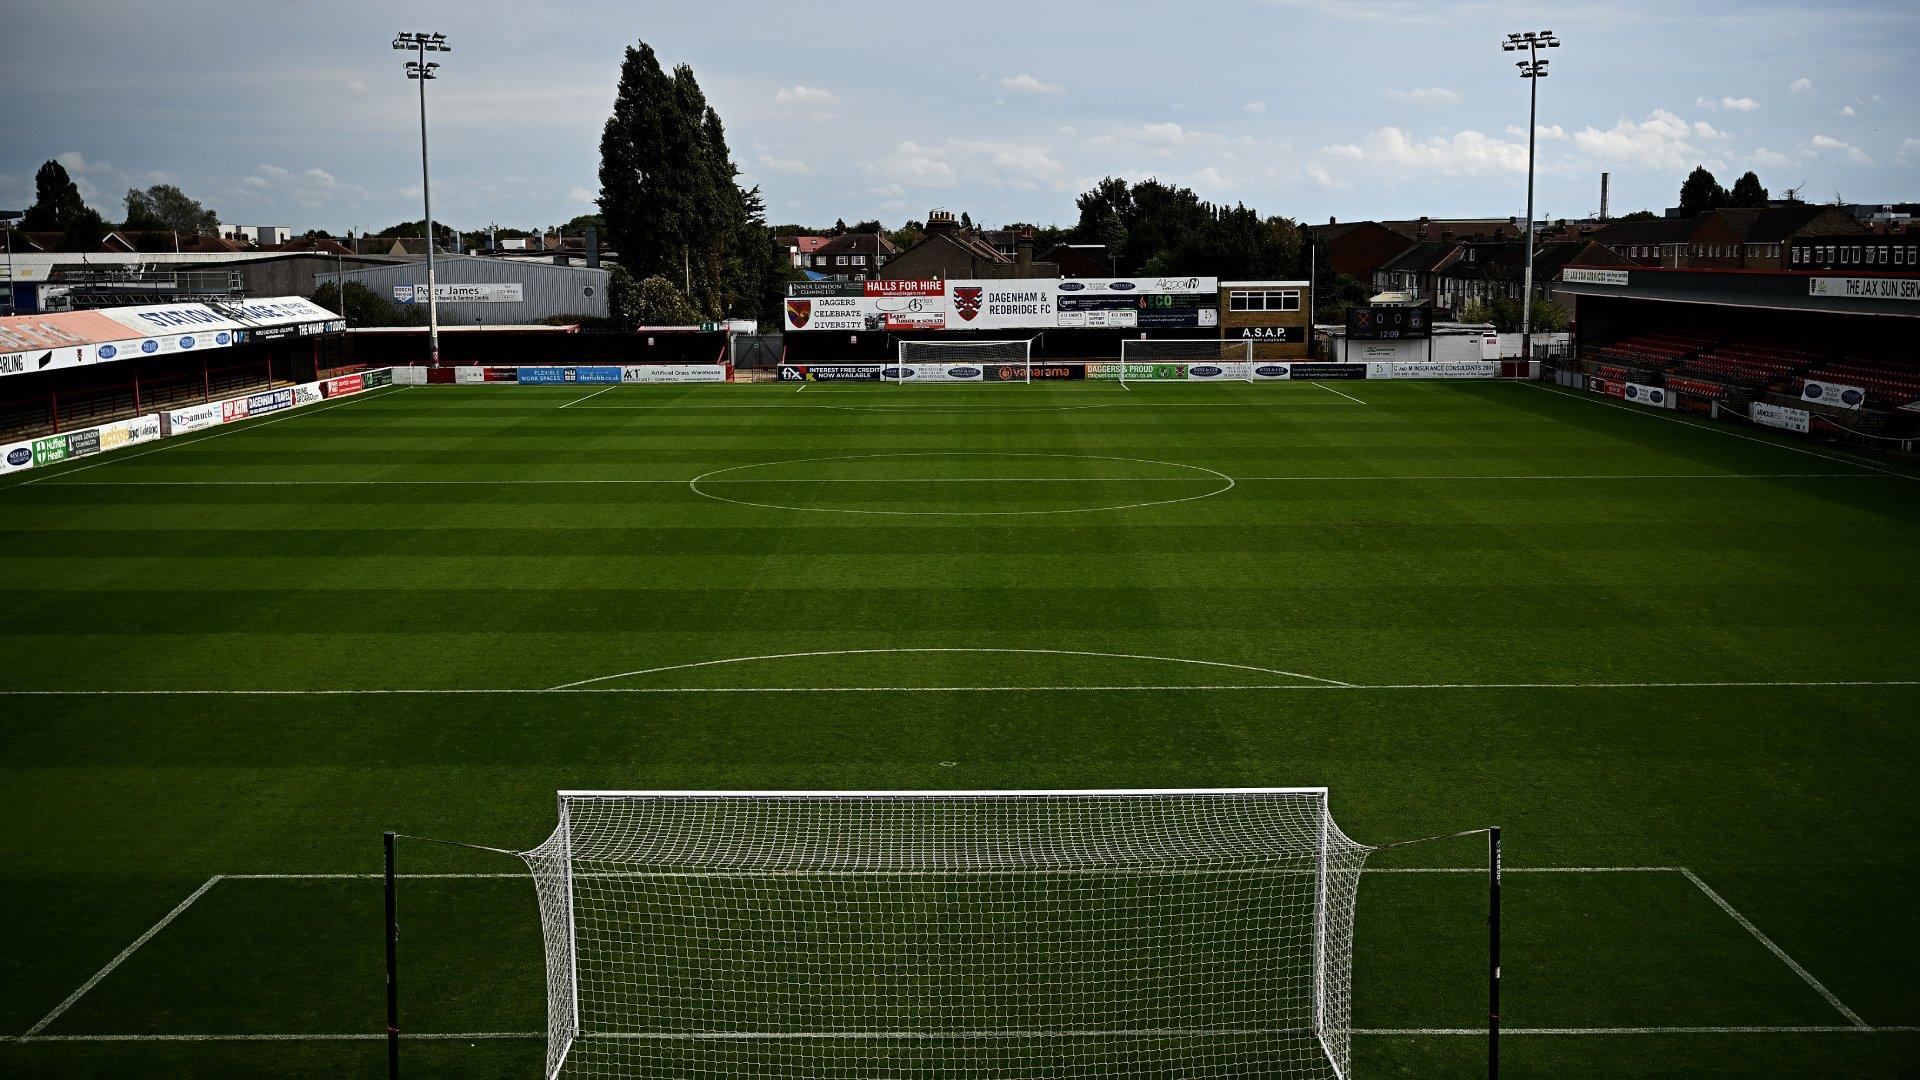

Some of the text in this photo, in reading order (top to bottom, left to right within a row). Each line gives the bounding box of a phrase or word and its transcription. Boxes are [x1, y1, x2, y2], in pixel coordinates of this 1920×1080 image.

[417, 286, 479, 295] Peer James
[867, 281, 897, 291] HALLS
[899, 281, 917, 291] FOR
[920, 281, 942, 290] HIRE
[1846, 280, 1860, 295] THE
[1861, 280, 1878, 296] JAX
[1881, 281, 1898, 297] SUN
[989, 292, 1047, 303] DAGENHAM &
[1148, 295, 1172, 307] ECO
[989, 304, 1051, 315] REDBRIDGE FC
[298, 323, 308, 336] THE
[308, 322, 325, 335] WHARF
[814, 321, 861, 329] DIVERSITY
[1242, 327, 1286, 338] A.S.A.P.
[782, 367, 803, 379] fix
[1012, 367, 1070, 377] vanarama
[1088, 365, 1121, 373] DAGGERS
[1129, 365, 1154, 373] PROUD
[249, 393, 274, 409] DAGENHAM
[274, 390, 291, 402] TRAVEL
[46, 437, 67, 450] Nuffield
[47, 449, 65, 461] Health
